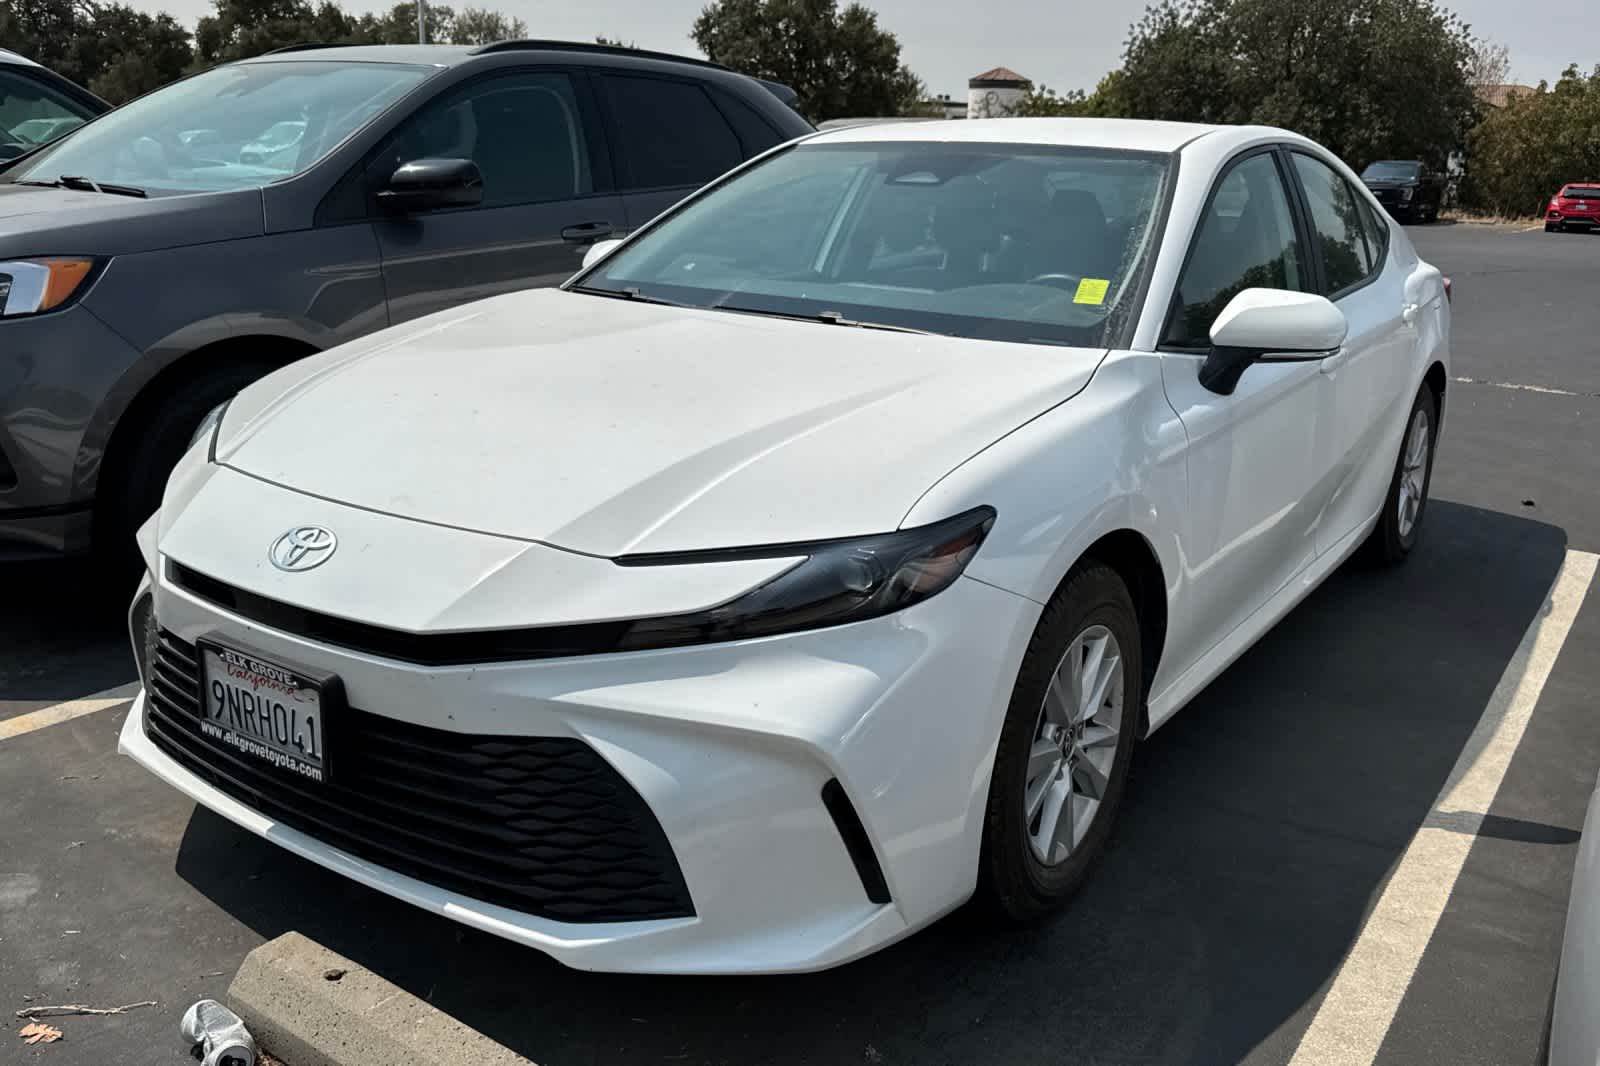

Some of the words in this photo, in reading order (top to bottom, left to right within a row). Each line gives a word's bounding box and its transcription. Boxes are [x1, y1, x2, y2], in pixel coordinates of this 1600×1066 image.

[225, 651, 248, 670] ELK
[250, 661, 293, 686] GROVE
[201, 719, 322, 781] www.elkgrovetoyota.com
[211, 679, 321, 761] 9NRH041
